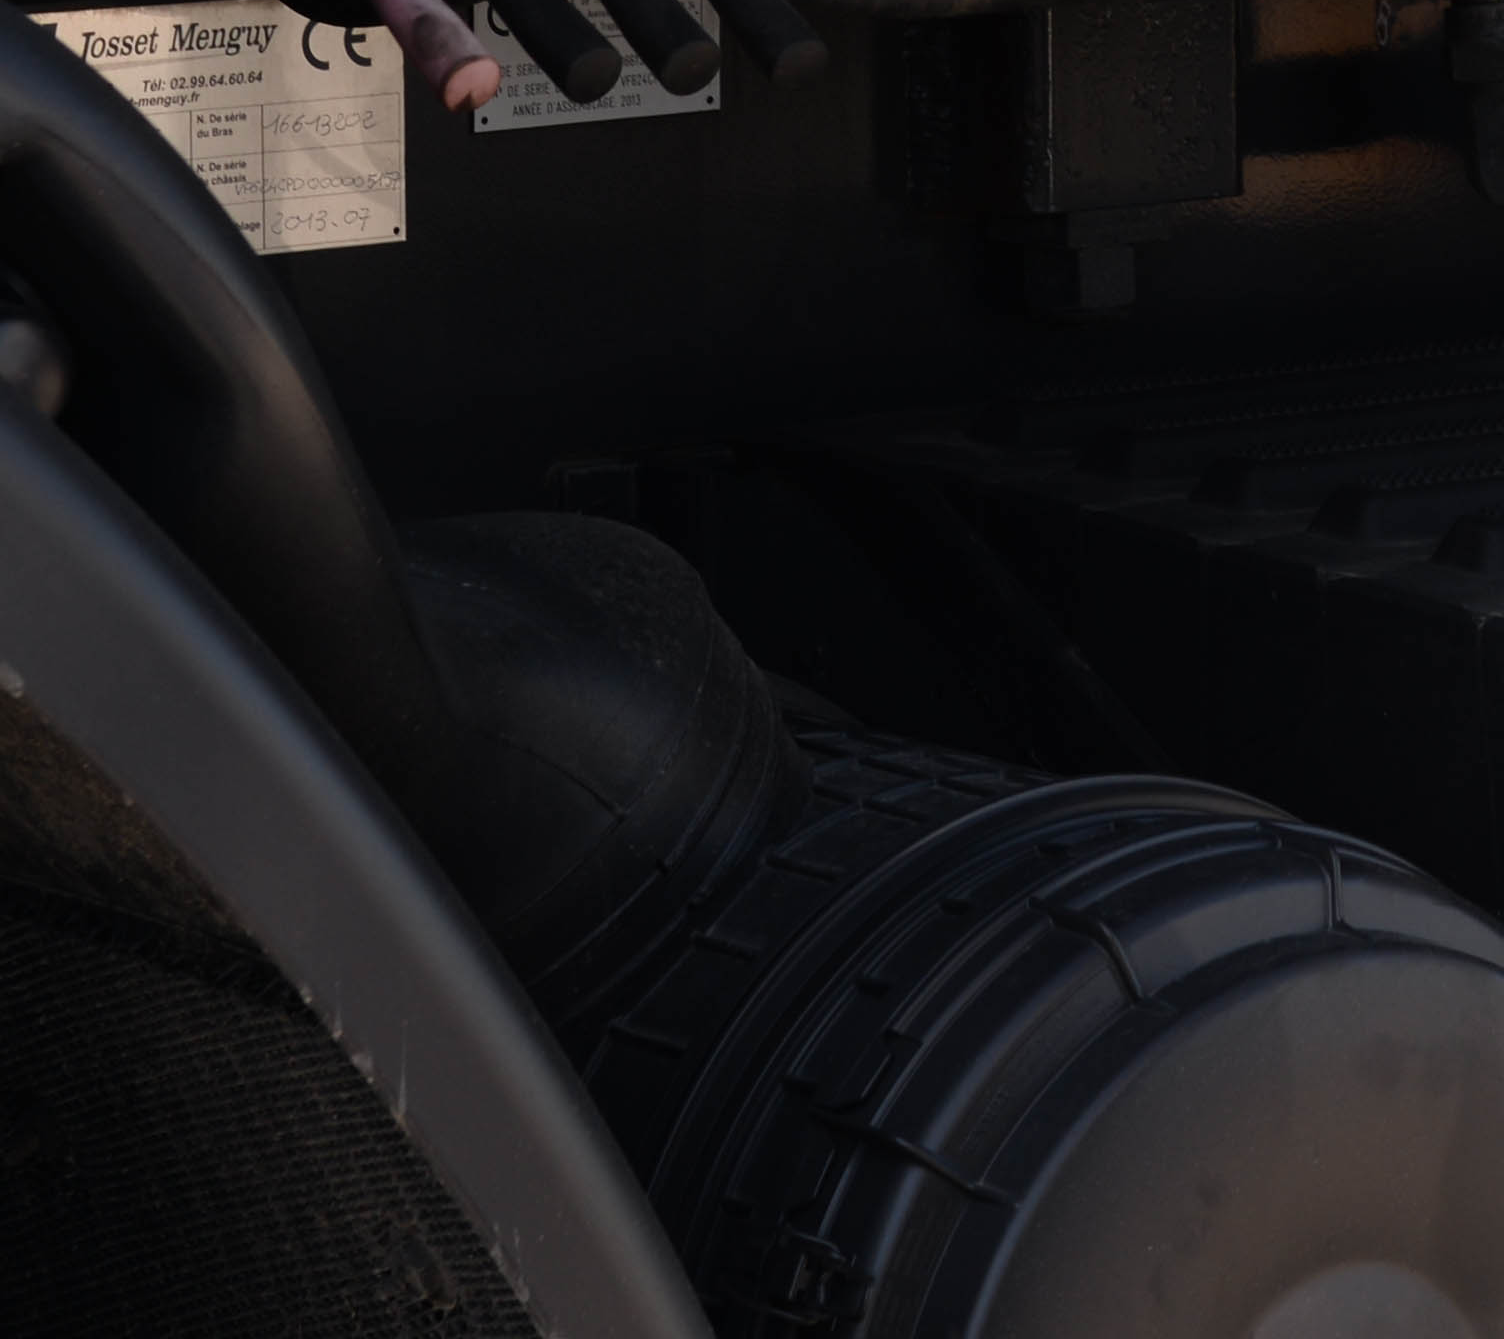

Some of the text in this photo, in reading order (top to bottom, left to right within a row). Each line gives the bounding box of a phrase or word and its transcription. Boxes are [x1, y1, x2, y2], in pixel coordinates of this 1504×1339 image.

[81, 21, 372, 71] Josset Menguy CE
[142, 70, 263, 94] Tél: 02.99.64.60.64
[130, 91, 200, 108] t-menguy.fr
[209, 112, 222, 123] De
[224, 110, 247, 123] série
[196, 127, 233, 139] du Bras
[209, 161, 222, 172] De
